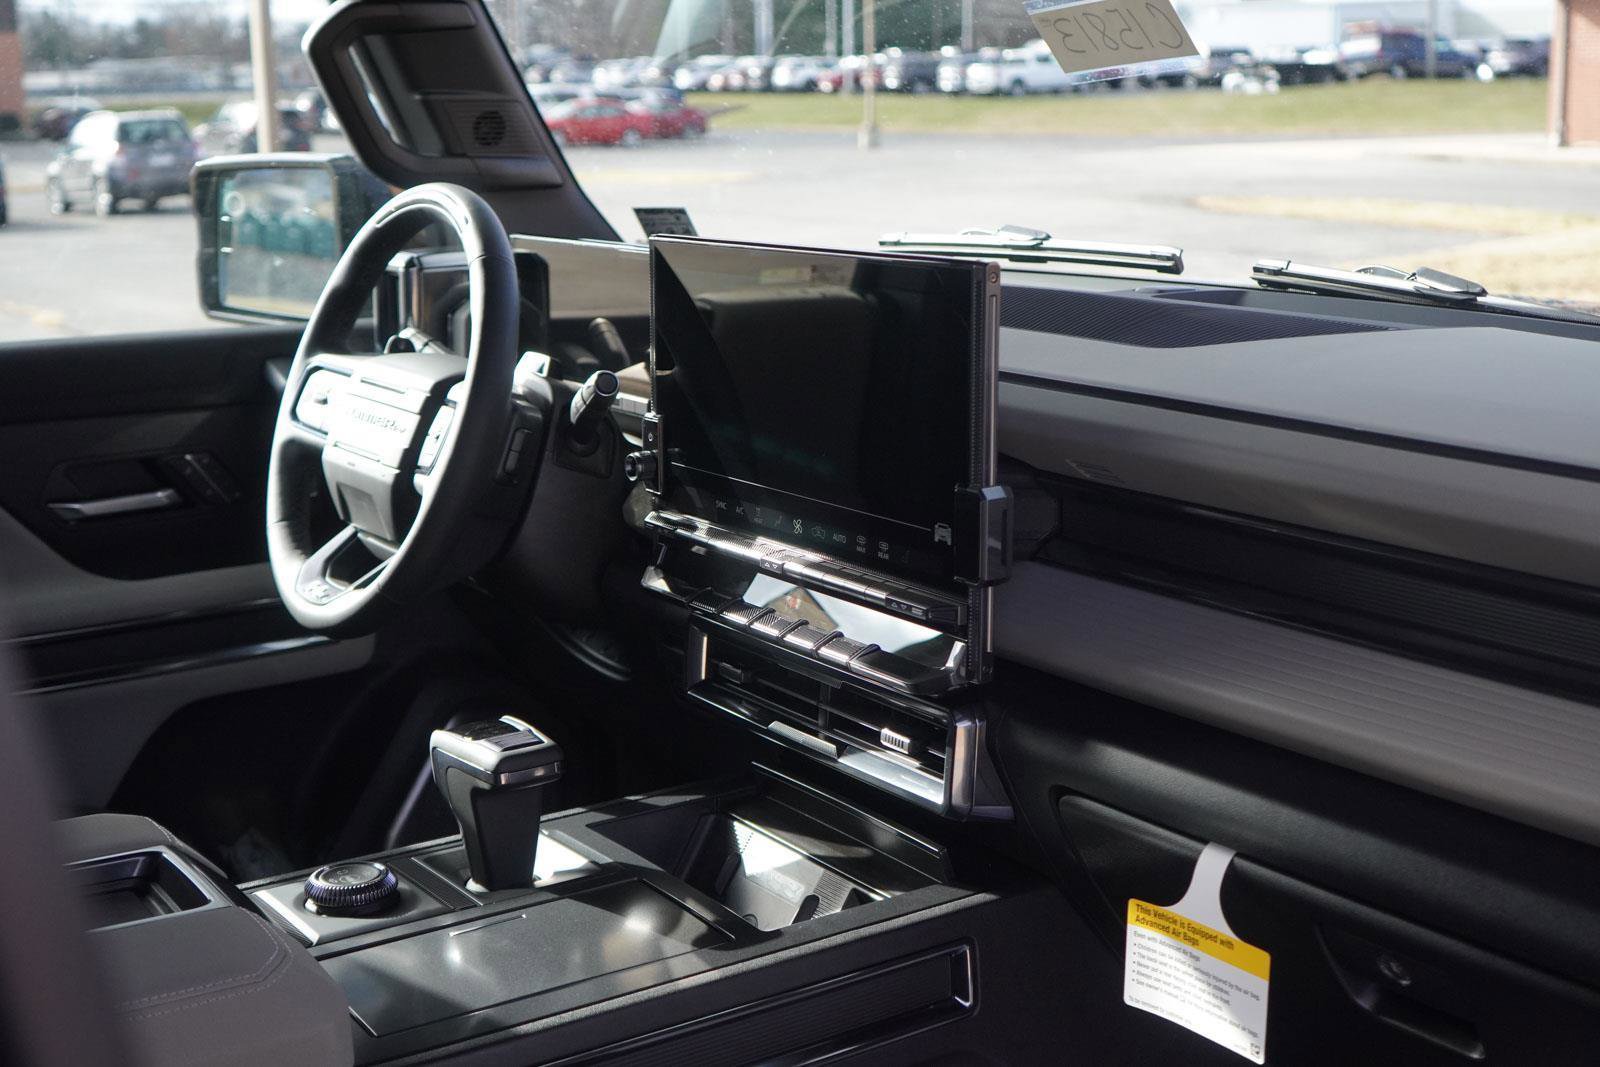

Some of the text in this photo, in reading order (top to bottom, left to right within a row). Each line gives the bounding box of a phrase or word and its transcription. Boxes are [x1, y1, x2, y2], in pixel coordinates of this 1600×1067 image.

[832, 532, 847, 544] AUTO
[1136, 904, 1151, 915] This
[1153, 910, 1177, 926] Vehicle
[1187, 923, 1217, 943] Equipped
[1136, 914, 1199, 947] Advanced Air Bags
